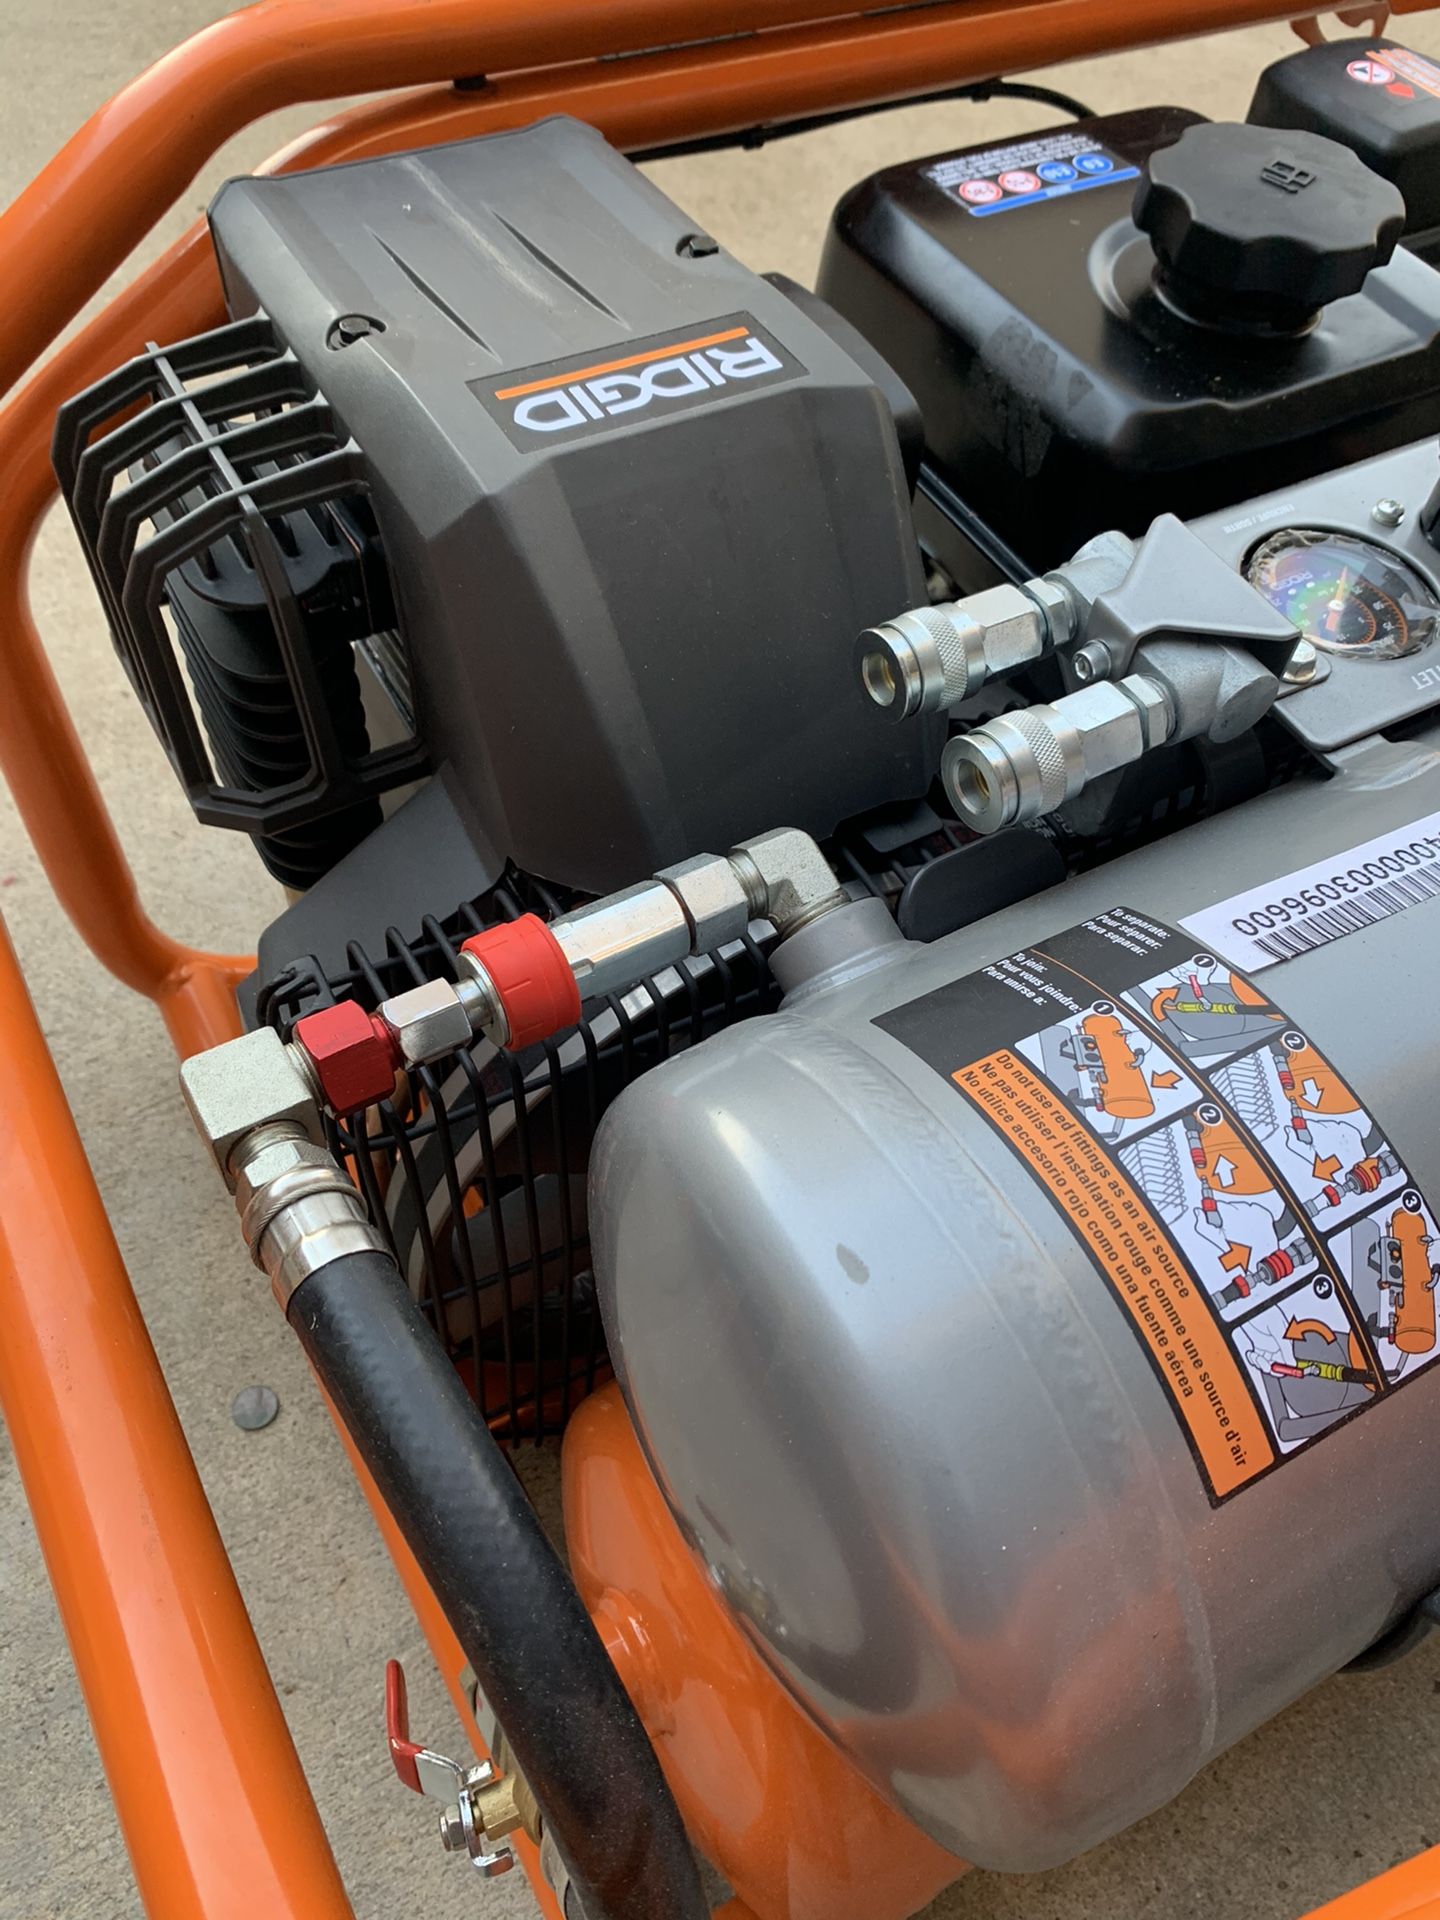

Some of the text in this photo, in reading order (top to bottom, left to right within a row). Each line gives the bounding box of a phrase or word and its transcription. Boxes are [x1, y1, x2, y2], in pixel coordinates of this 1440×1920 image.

[514, 337, 783, 431] RIDGID
[1081, 921, 1149, 957] Para separar:
[1096, 914, 1164, 950] Pour séparer:
[1110, 908, 1171, 940] To separate:
[982, 966, 1048, 1006] Para unirse a:
[996, 959, 1083, 1013] Pour vous joindre:
[1012, 952, 1048, 974] To join:
[996, 1054, 1190, 1299] Do not use red fittings as an air source
[961, 1070, 1195, 1398] No utilice accesorio rojo como una fuente aérea
[978, 1062, 1248, 1468] Ne pas utiliser l'installation rouge comme une source d'air
